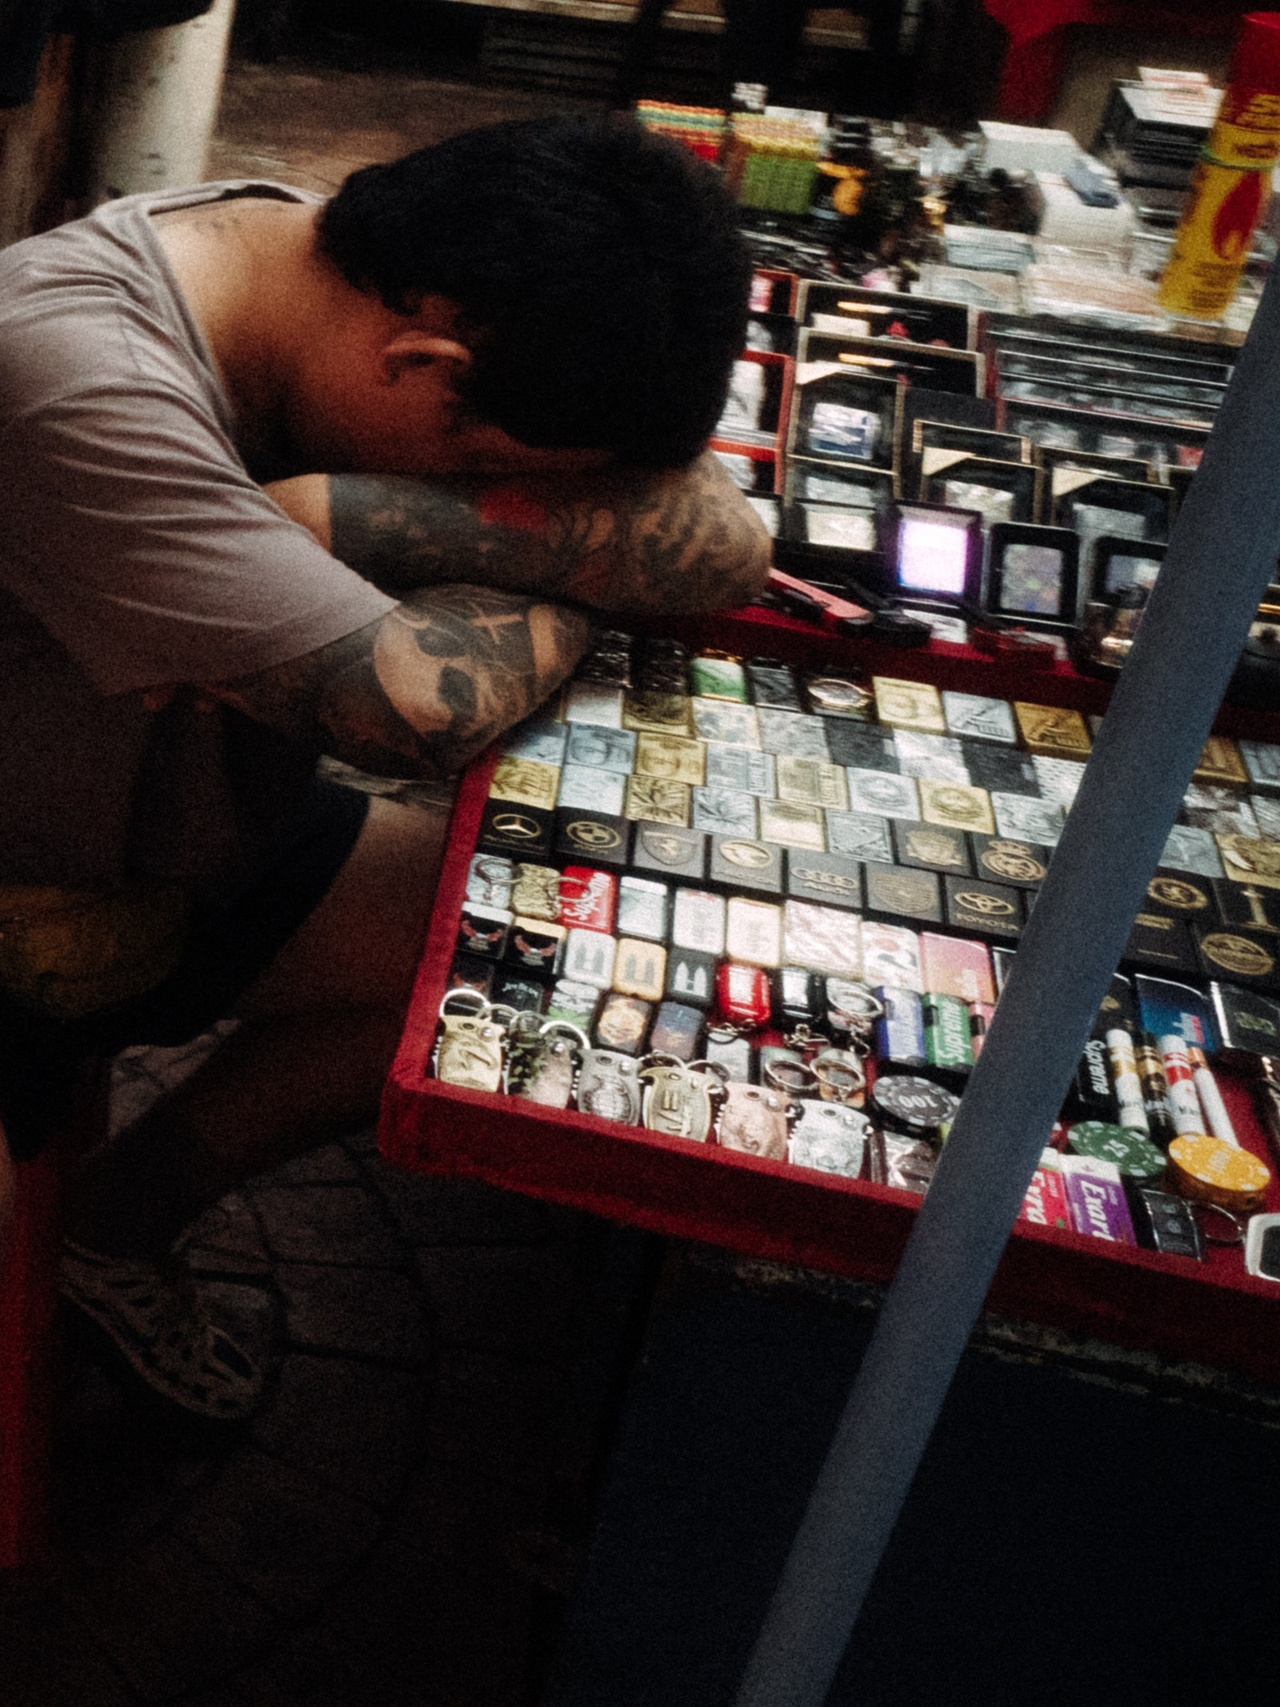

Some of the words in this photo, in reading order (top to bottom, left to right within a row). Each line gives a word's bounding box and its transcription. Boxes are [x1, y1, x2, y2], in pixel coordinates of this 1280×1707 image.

[936, 1001, 971, 1062] Supreme
[1085, 1039, 1110, 1096] Supreme
[897, 1095, 938, 1109] 100
[1102, 1138, 1130, 1158] 25
